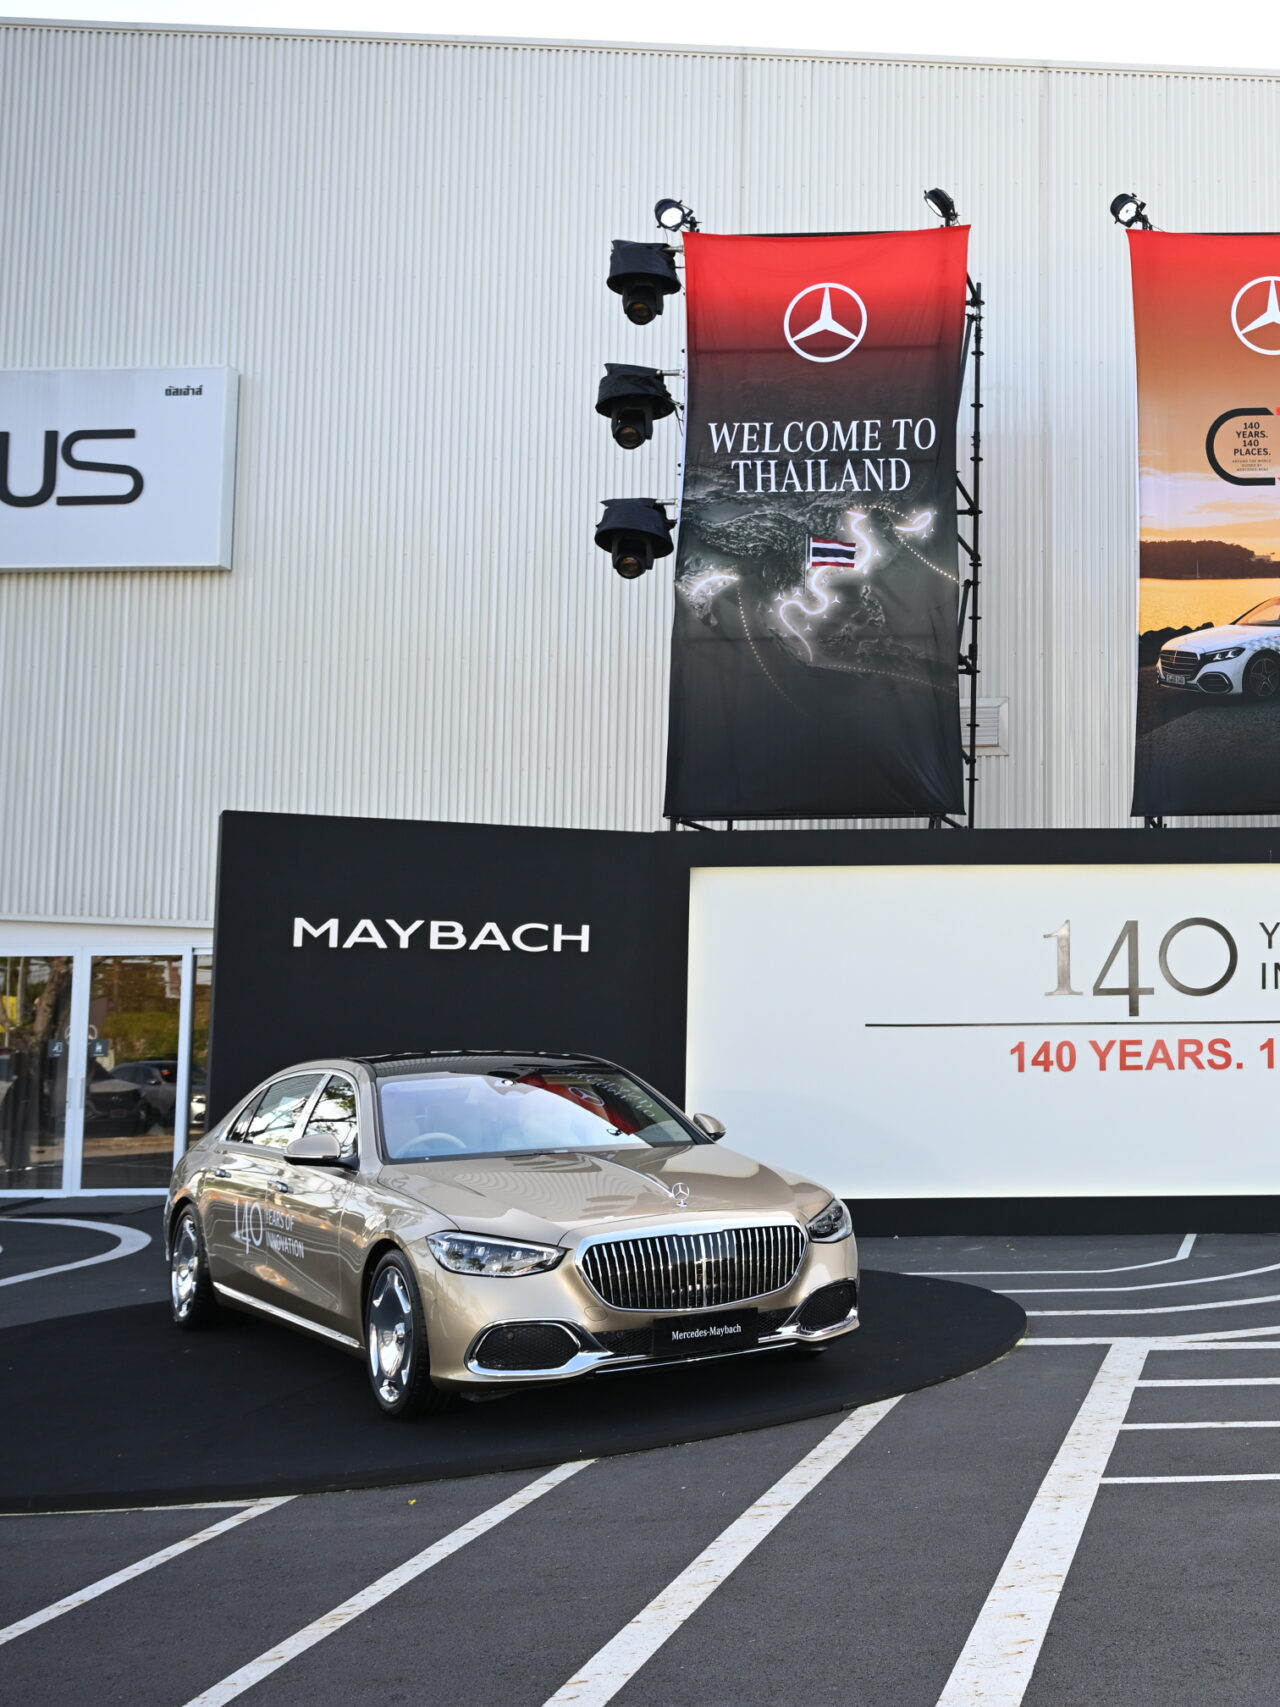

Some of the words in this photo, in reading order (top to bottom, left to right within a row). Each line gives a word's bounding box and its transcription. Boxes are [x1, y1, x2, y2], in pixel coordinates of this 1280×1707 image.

[708, 420, 882, 454] WELCOME
[892, 418, 937, 450] TO
[1236, 430, 1269, 439] YEARS.
[1243, 422, 1260, 430] 140
[1233, 447, 1271, 456] PLACES.
[1242, 439, 1260, 447] 140
[731, 457, 911, 493] THAILAND
[293, 917, 590, 952] MAYBACH
[1042, 917, 1238, 1017] 140
[1010, 1040, 1077, 1073] 140
[1089, 1038, 1243, 1072] YEARS.
[233, 1200, 263, 1255] 140
[285, 1213, 295, 1231] OF
[671, 1323, 742, 1341] Mercedes-Maybach
